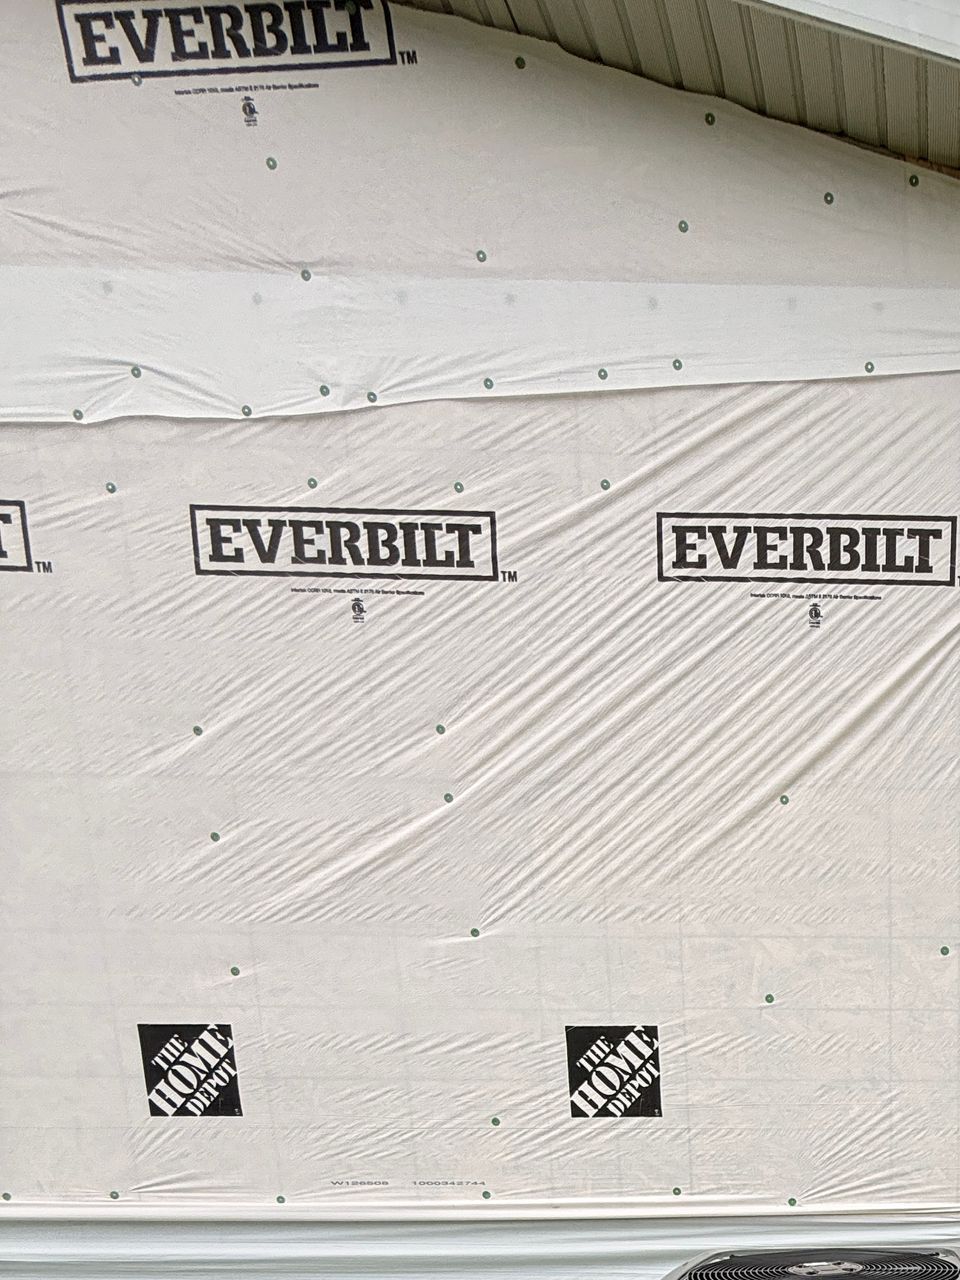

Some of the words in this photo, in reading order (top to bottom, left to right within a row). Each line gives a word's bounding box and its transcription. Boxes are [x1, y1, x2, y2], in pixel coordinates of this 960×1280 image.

[74, 0, 374, 66] EVERBILT
[206, 517, 482, 569] EVERBILT
[671, 525, 943, 574] EVERBILT
[148, 1024, 234, 1116] HOME
[151, 1034, 188, 1071] THE
[570, 1026, 659, 1117] HOME
[576, 1036, 614, 1072] THE
[185, 1059, 237, 1116] DEPOT
[606, 1060, 660, 1117] DEPOT
